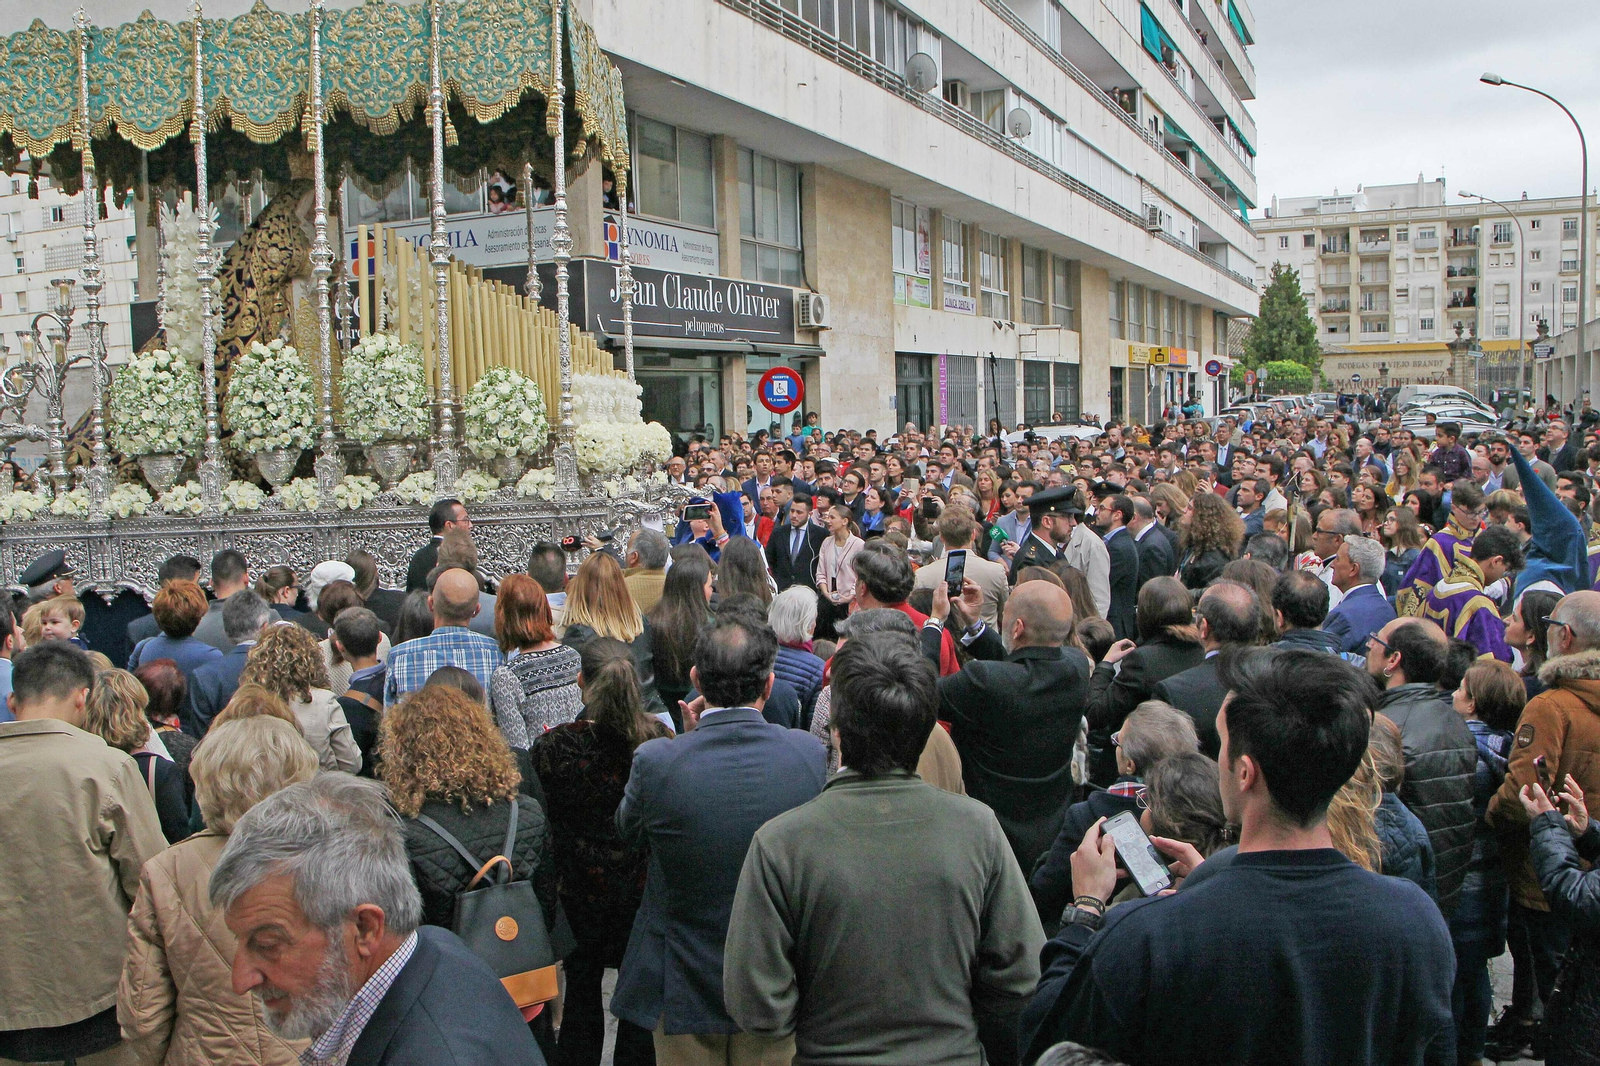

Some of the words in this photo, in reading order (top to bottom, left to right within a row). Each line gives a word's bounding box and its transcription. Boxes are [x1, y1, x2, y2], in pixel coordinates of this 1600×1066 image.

[488, 225, 524, 239] Administración
[533, 225, 547, 234] incas
[485, 241, 521, 254] Asesoramiento
[521, 238, 552, 251] emesaria
[610, 266, 657, 306] Jan
[662, 273, 723, 314] Claude
[726, 282, 780, 319] Olivier
[685, 317, 725, 336] peluqueros
[1338, 361, 1370, 369] BODEGAS
[1388, 360, 1410, 368] VIEJO
[1412, 360, 1444, 368] BRANDY
